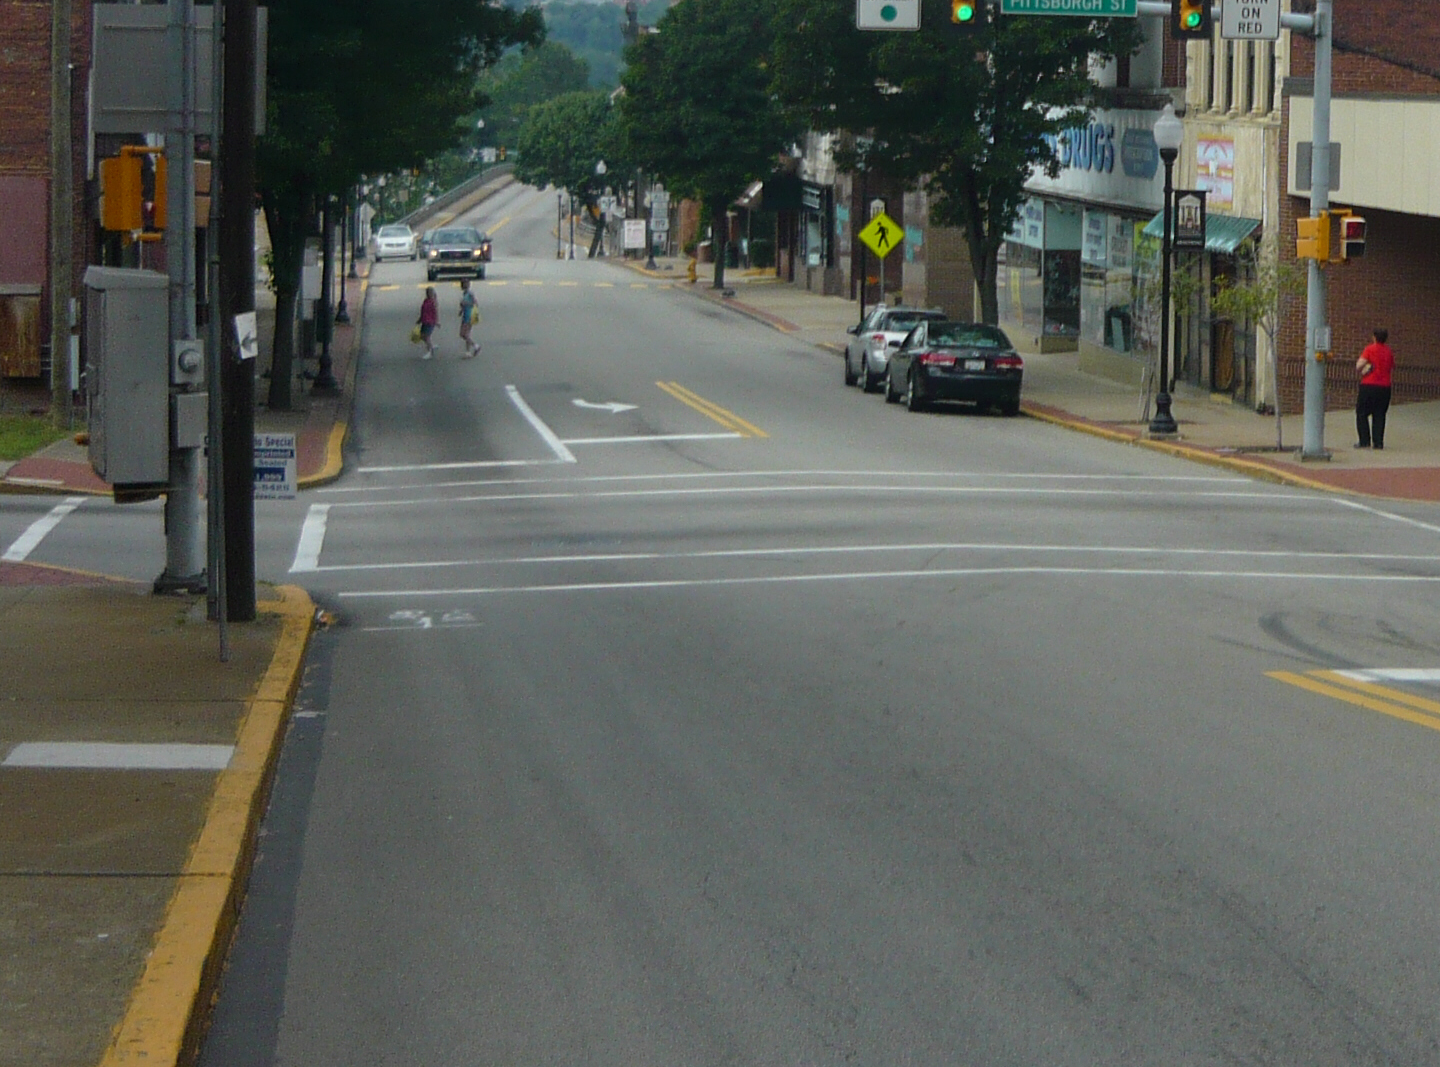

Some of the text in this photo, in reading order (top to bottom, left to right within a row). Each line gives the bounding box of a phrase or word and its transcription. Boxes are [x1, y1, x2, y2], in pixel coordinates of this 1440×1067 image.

[1241, 7, 1260, 19] ON
[1238, 22, 1262, 34] RED
[1061, 123, 1115, 174] DRUGS
